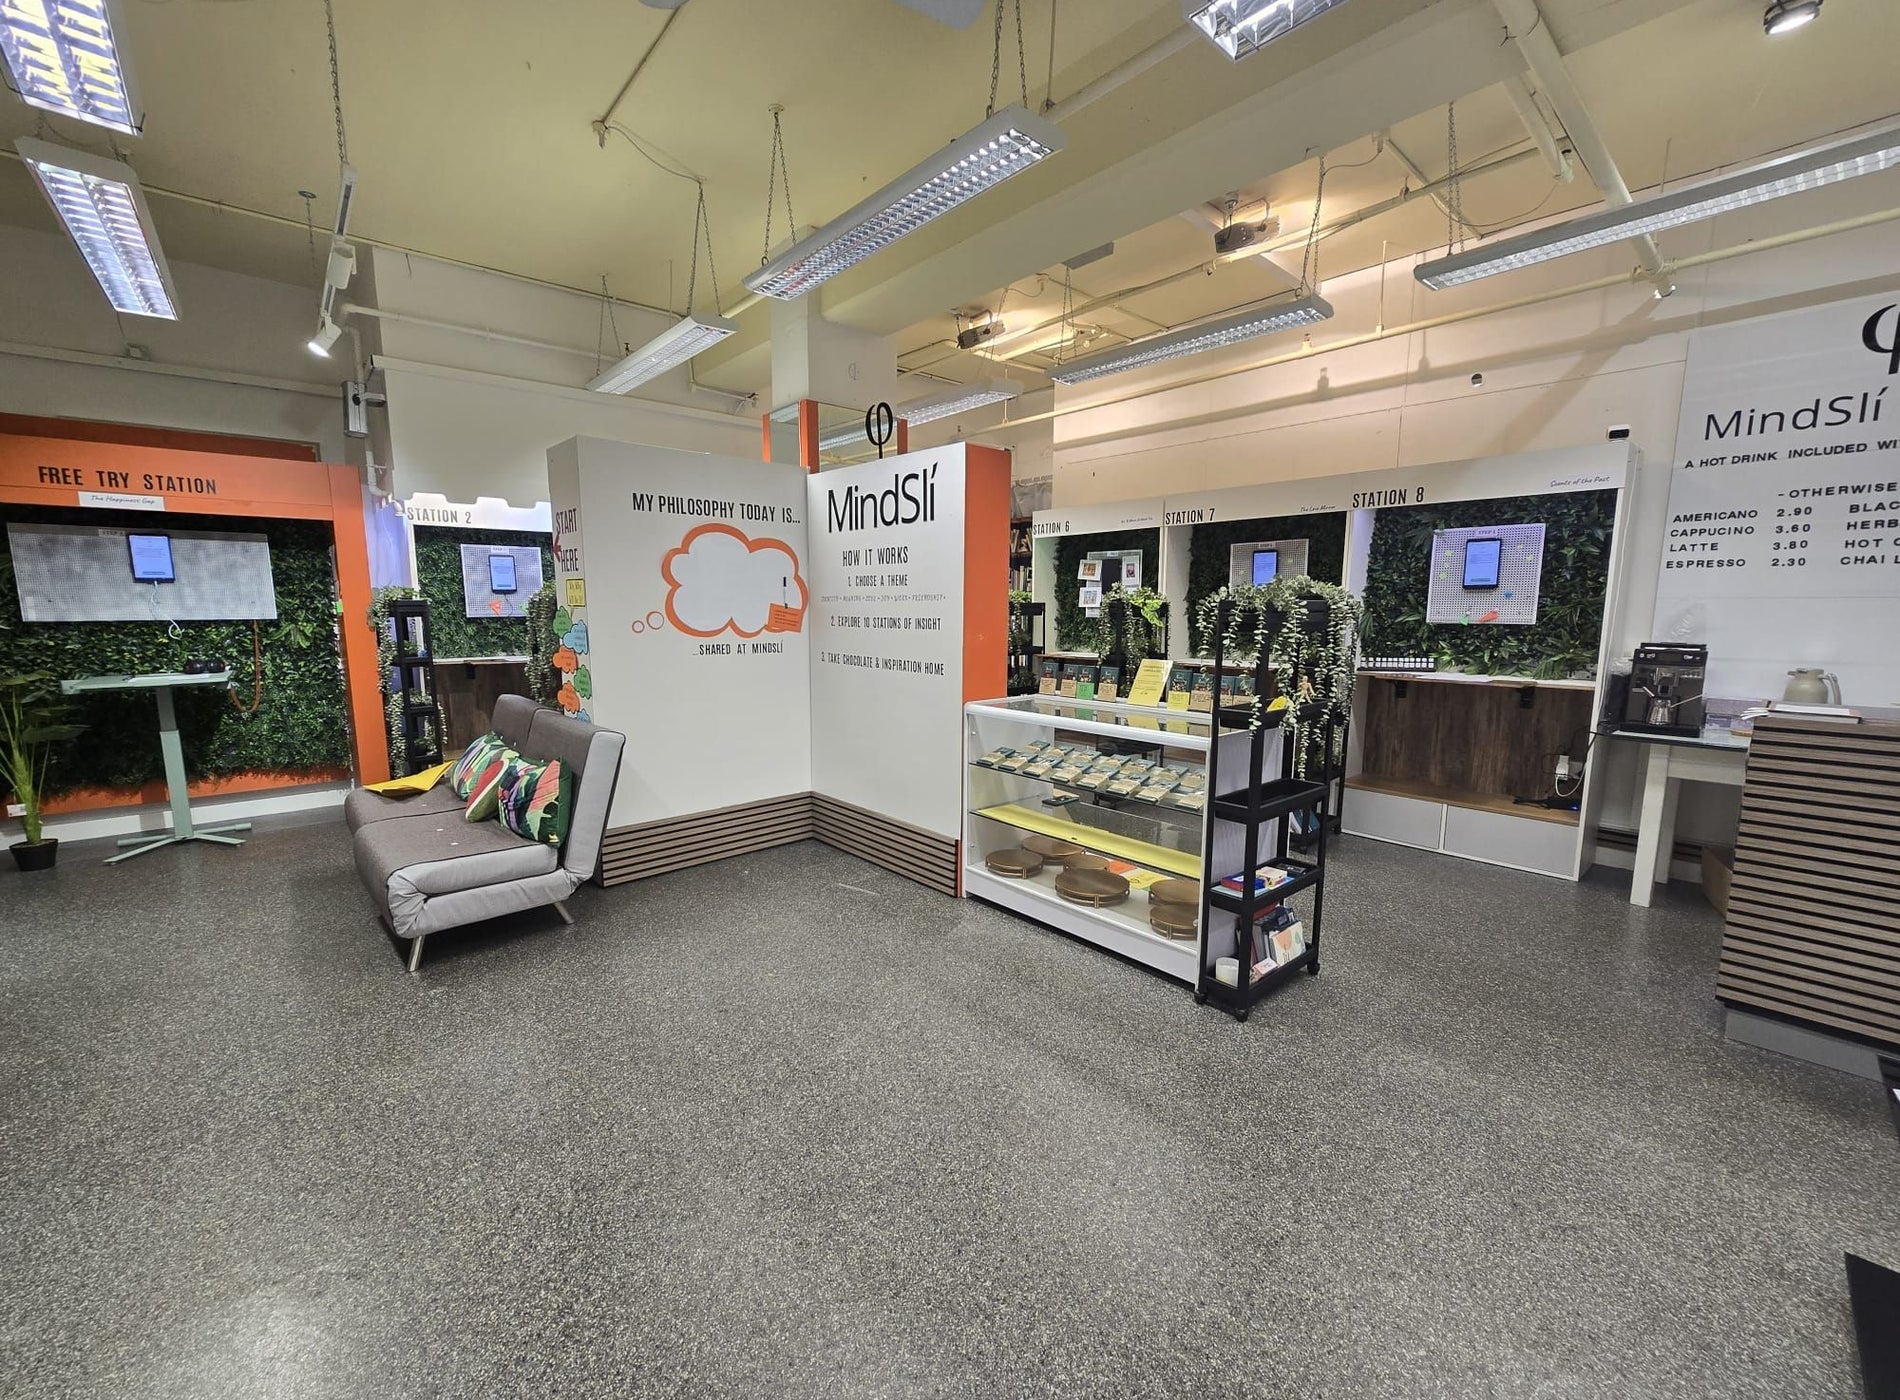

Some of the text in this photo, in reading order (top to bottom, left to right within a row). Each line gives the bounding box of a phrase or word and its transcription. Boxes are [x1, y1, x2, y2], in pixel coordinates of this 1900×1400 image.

[1704, 386, 1889, 441] MindSlí
[1685, 439, 1900, 469] A HOT DRINK INCLUDED WI
[38, 466, 217, 495] FREE TRY STATION
[828, 462, 938, 533] MindSlí
[1352, 486, 1425, 509] STATION 8
[407, 506, 472, 524] STATION 2
[632, 492, 654, 512] MY
[658, 495, 735, 519] PHILOSOPHY
[740, 503, 775, 522] TODAY
[1673, 506, 1813, 523] AMERICANO 2.90
[555, 508, 577, 534] START
[1165, 509, 1203, 525] STATION
[1208, 508, 1215, 522] 7
[1033, 520, 1070, 536] STATION 6
[1670, 523, 1811, 538] CAPPUCINO 3.60
[1669, 540, 1808, 552] LATTE 3.80
[1845, 538, 1883, 549] HOT
[561, 548, 579, 572] HERE
[842, 546, 909, 567] HOW IT WORKS
[1665, 557, 1806, 569] ESPRESSO 2.30
[1840, 554, 1885, 565] CHAI
[855, 575, 877, 587] CHOOSE
[880, 575, 885, 587] A
[887, 574, 908, 587] THEME
[838, 615, 861, 628] EXPLORE
[864, 616, 870, 628] 10
[872, 617, 901, 630] STATIONS
[903, 617, 912, 630] OF
[914, 617, 941, 631] INSIGHT
[737, 643, 747, 655] AT
[828, 652, 841, 665] TAKE
[843, 653, 873, 669] CHOCOLATE
[875, 656, 880, 669] &
[881, 657, 922, 674] INSPIRATION
[924, 662, 945, 676] HOME
